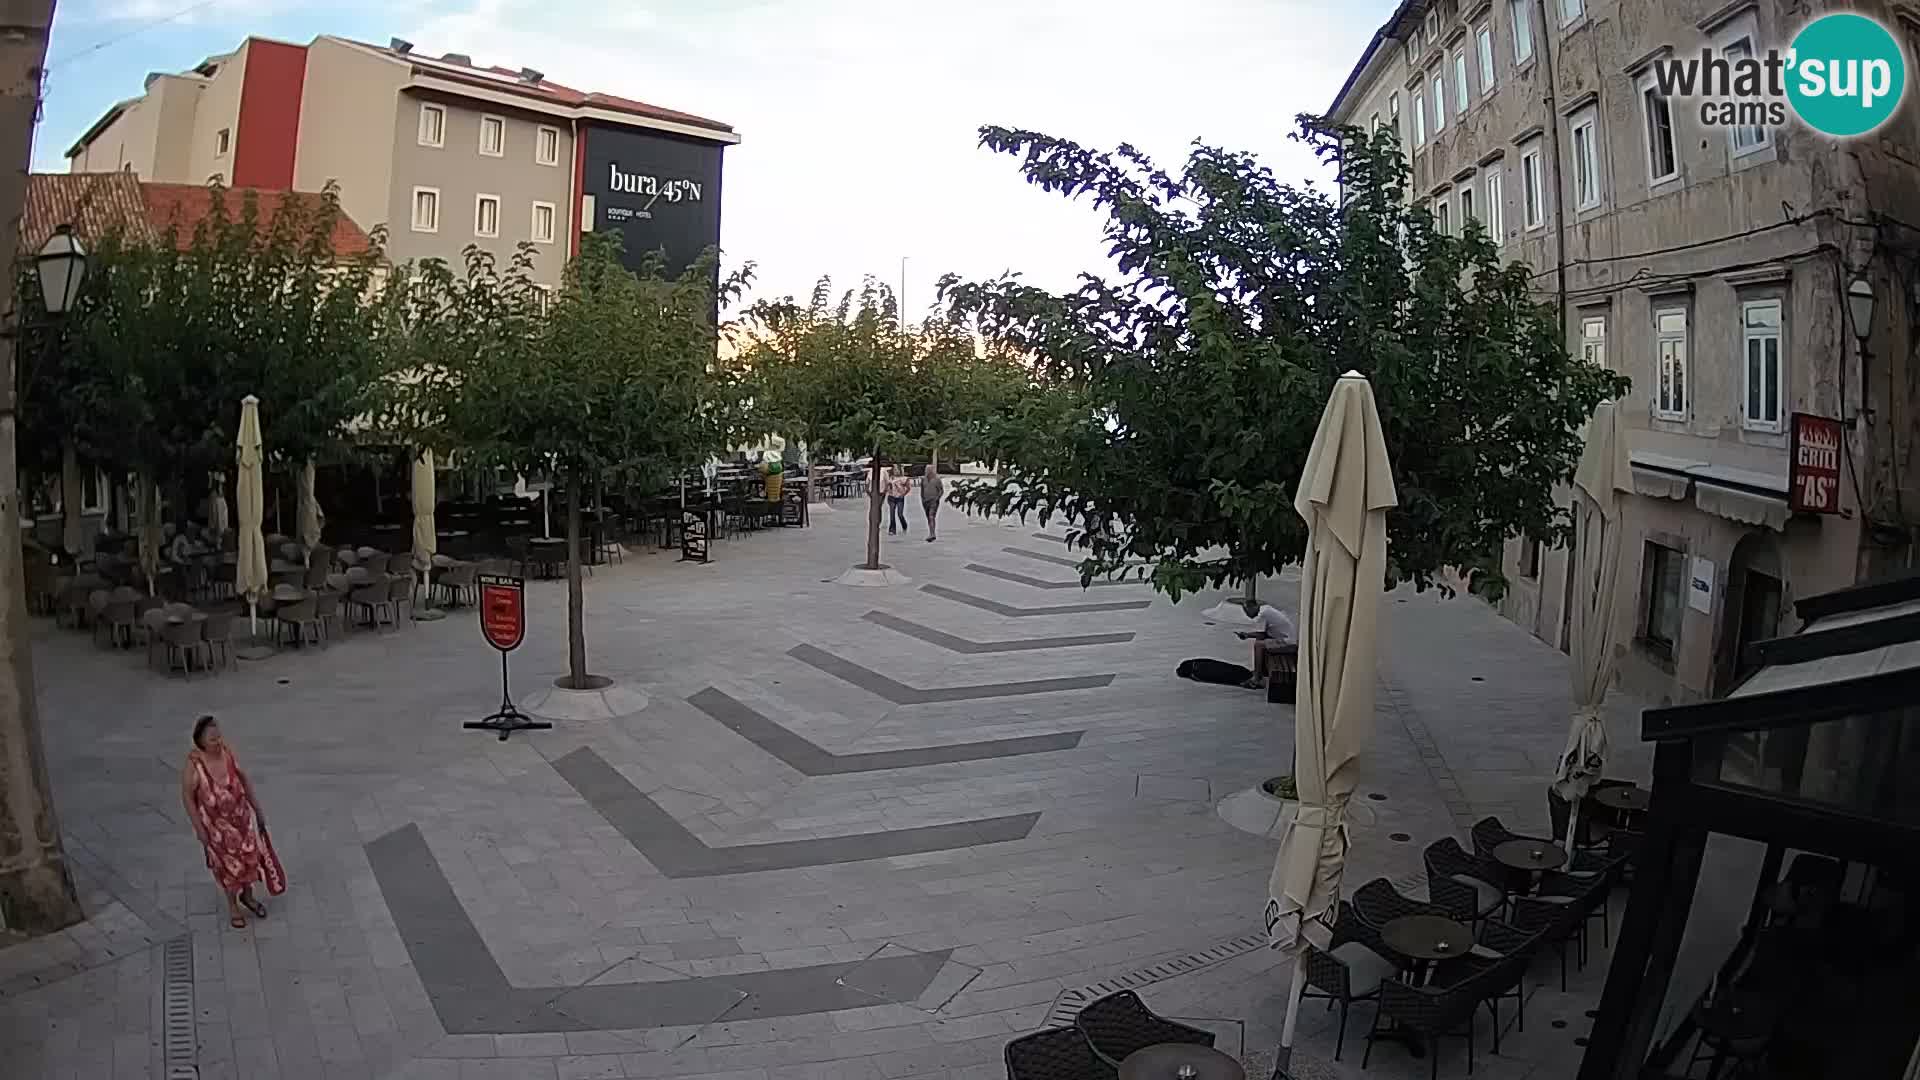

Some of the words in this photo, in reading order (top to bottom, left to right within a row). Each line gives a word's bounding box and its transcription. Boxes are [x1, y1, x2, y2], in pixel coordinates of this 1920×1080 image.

[610, 164, 657, 196] bura
[607, 207, 633, 217] BOUTIQUE
[635, 210, 652, 219] HOTEL
[1798, 446, 1838, 470] GRILL
[481, 576, 496, 584] WINE
[499, 577, 513, 585] BAR
